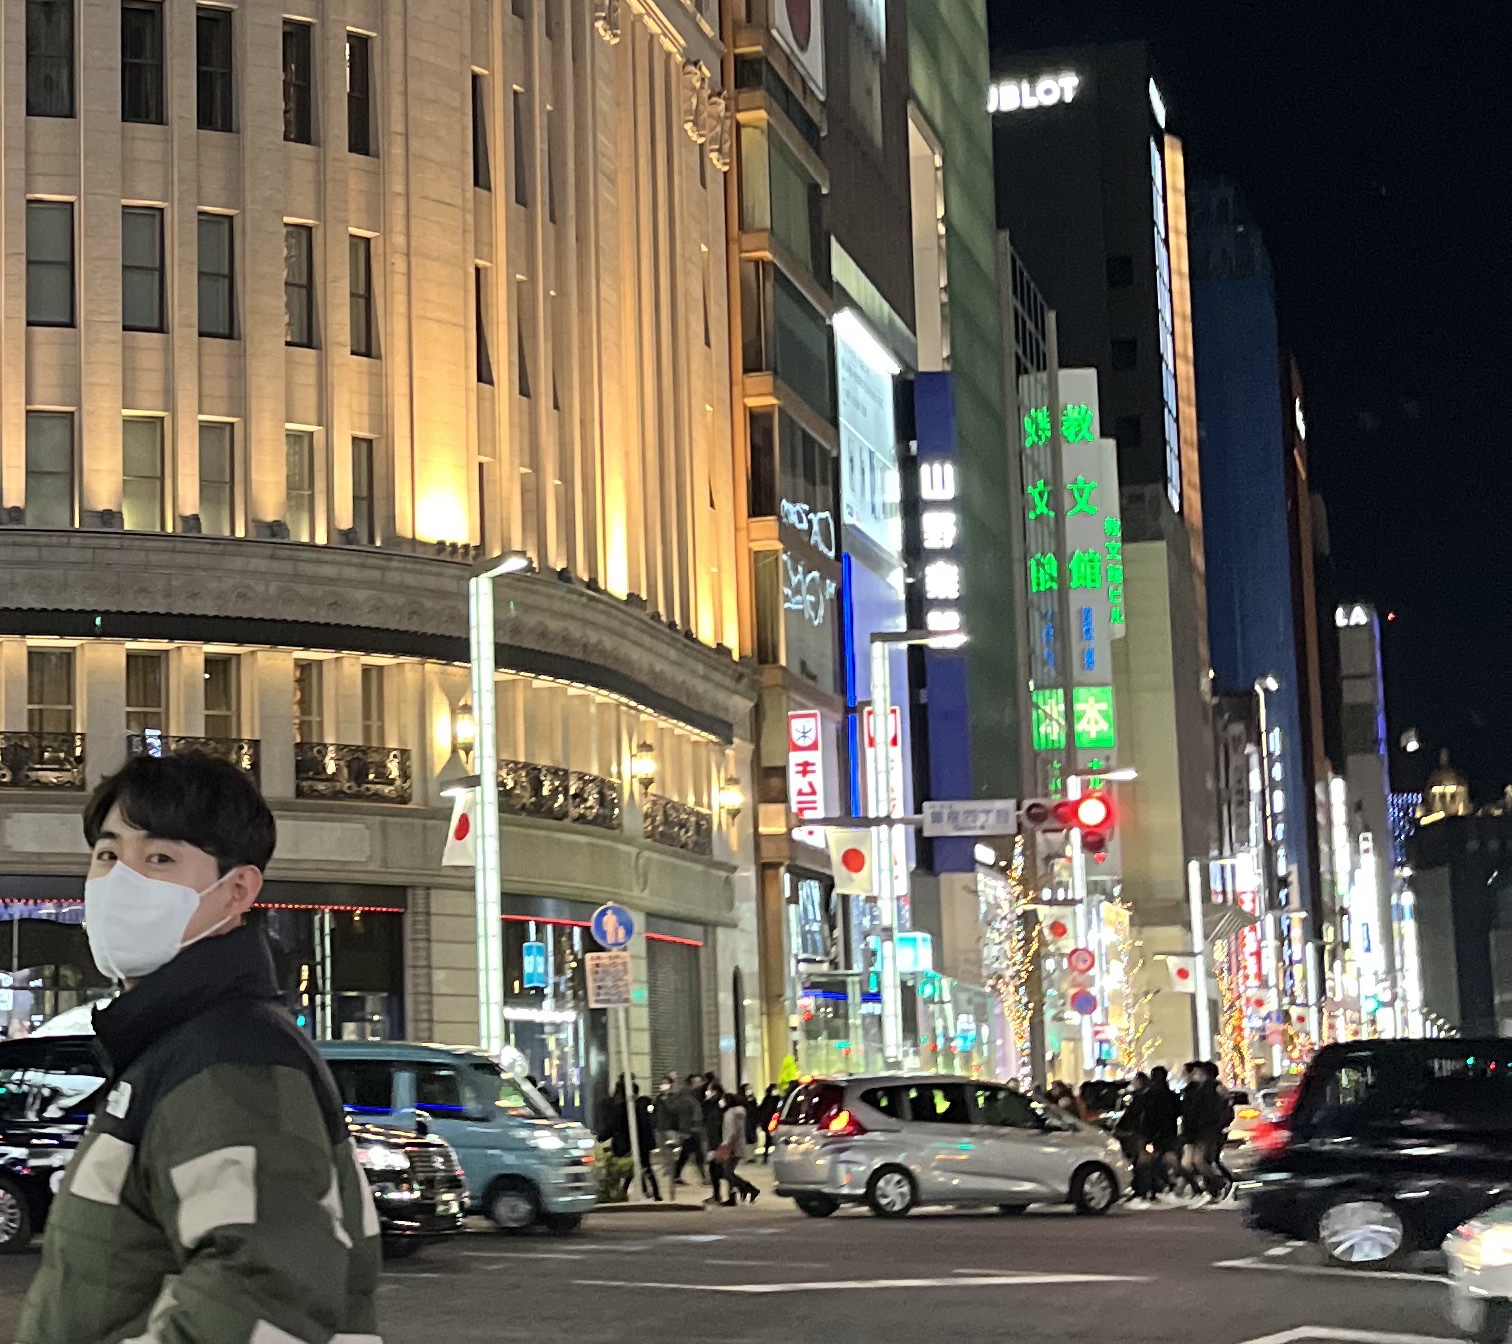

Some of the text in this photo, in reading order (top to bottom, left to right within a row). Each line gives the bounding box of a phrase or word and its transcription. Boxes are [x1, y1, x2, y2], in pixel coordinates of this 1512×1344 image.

[1061, 403, 1102, 590] 教文館
[1075, 695, 1109, 738] 本
[795, 760, 818, 836] キムラ
